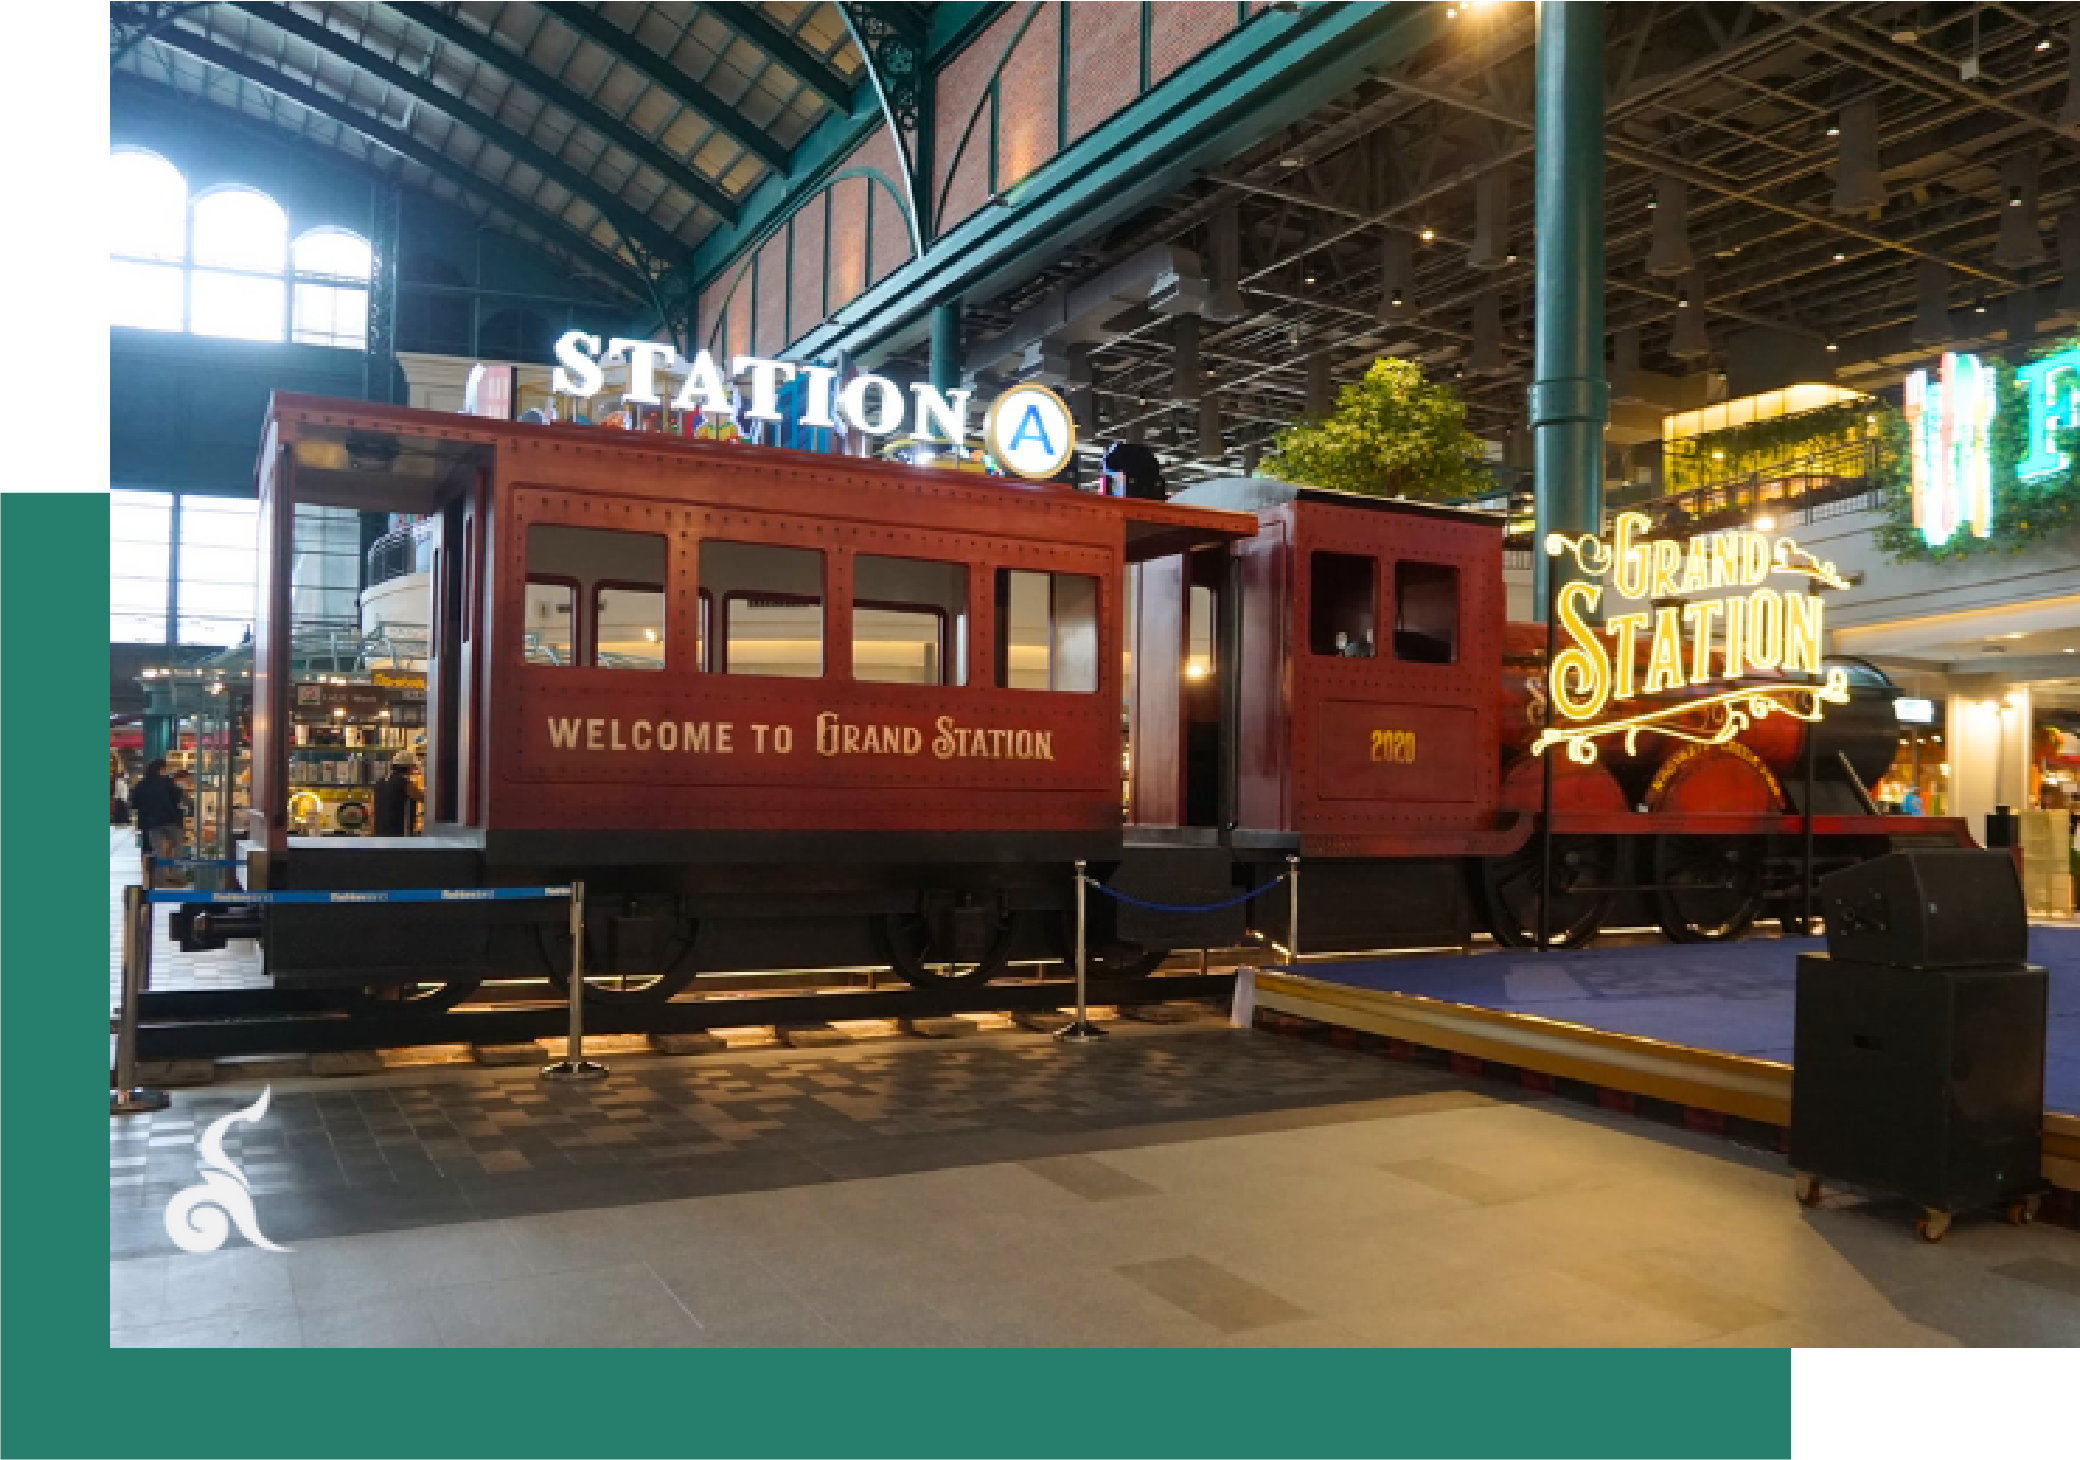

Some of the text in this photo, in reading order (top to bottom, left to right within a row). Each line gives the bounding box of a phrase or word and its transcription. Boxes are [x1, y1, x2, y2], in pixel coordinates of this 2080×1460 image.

[552, 330, 1056, 456] STATION A
[1612, 511, 1772, 600] GRAND
[1550, 580, 1826, 721] STATION
[547, 710, 1056, 761] WELCOME TO GRAND STATION
[1369, 729, 1416, 765] 2020
